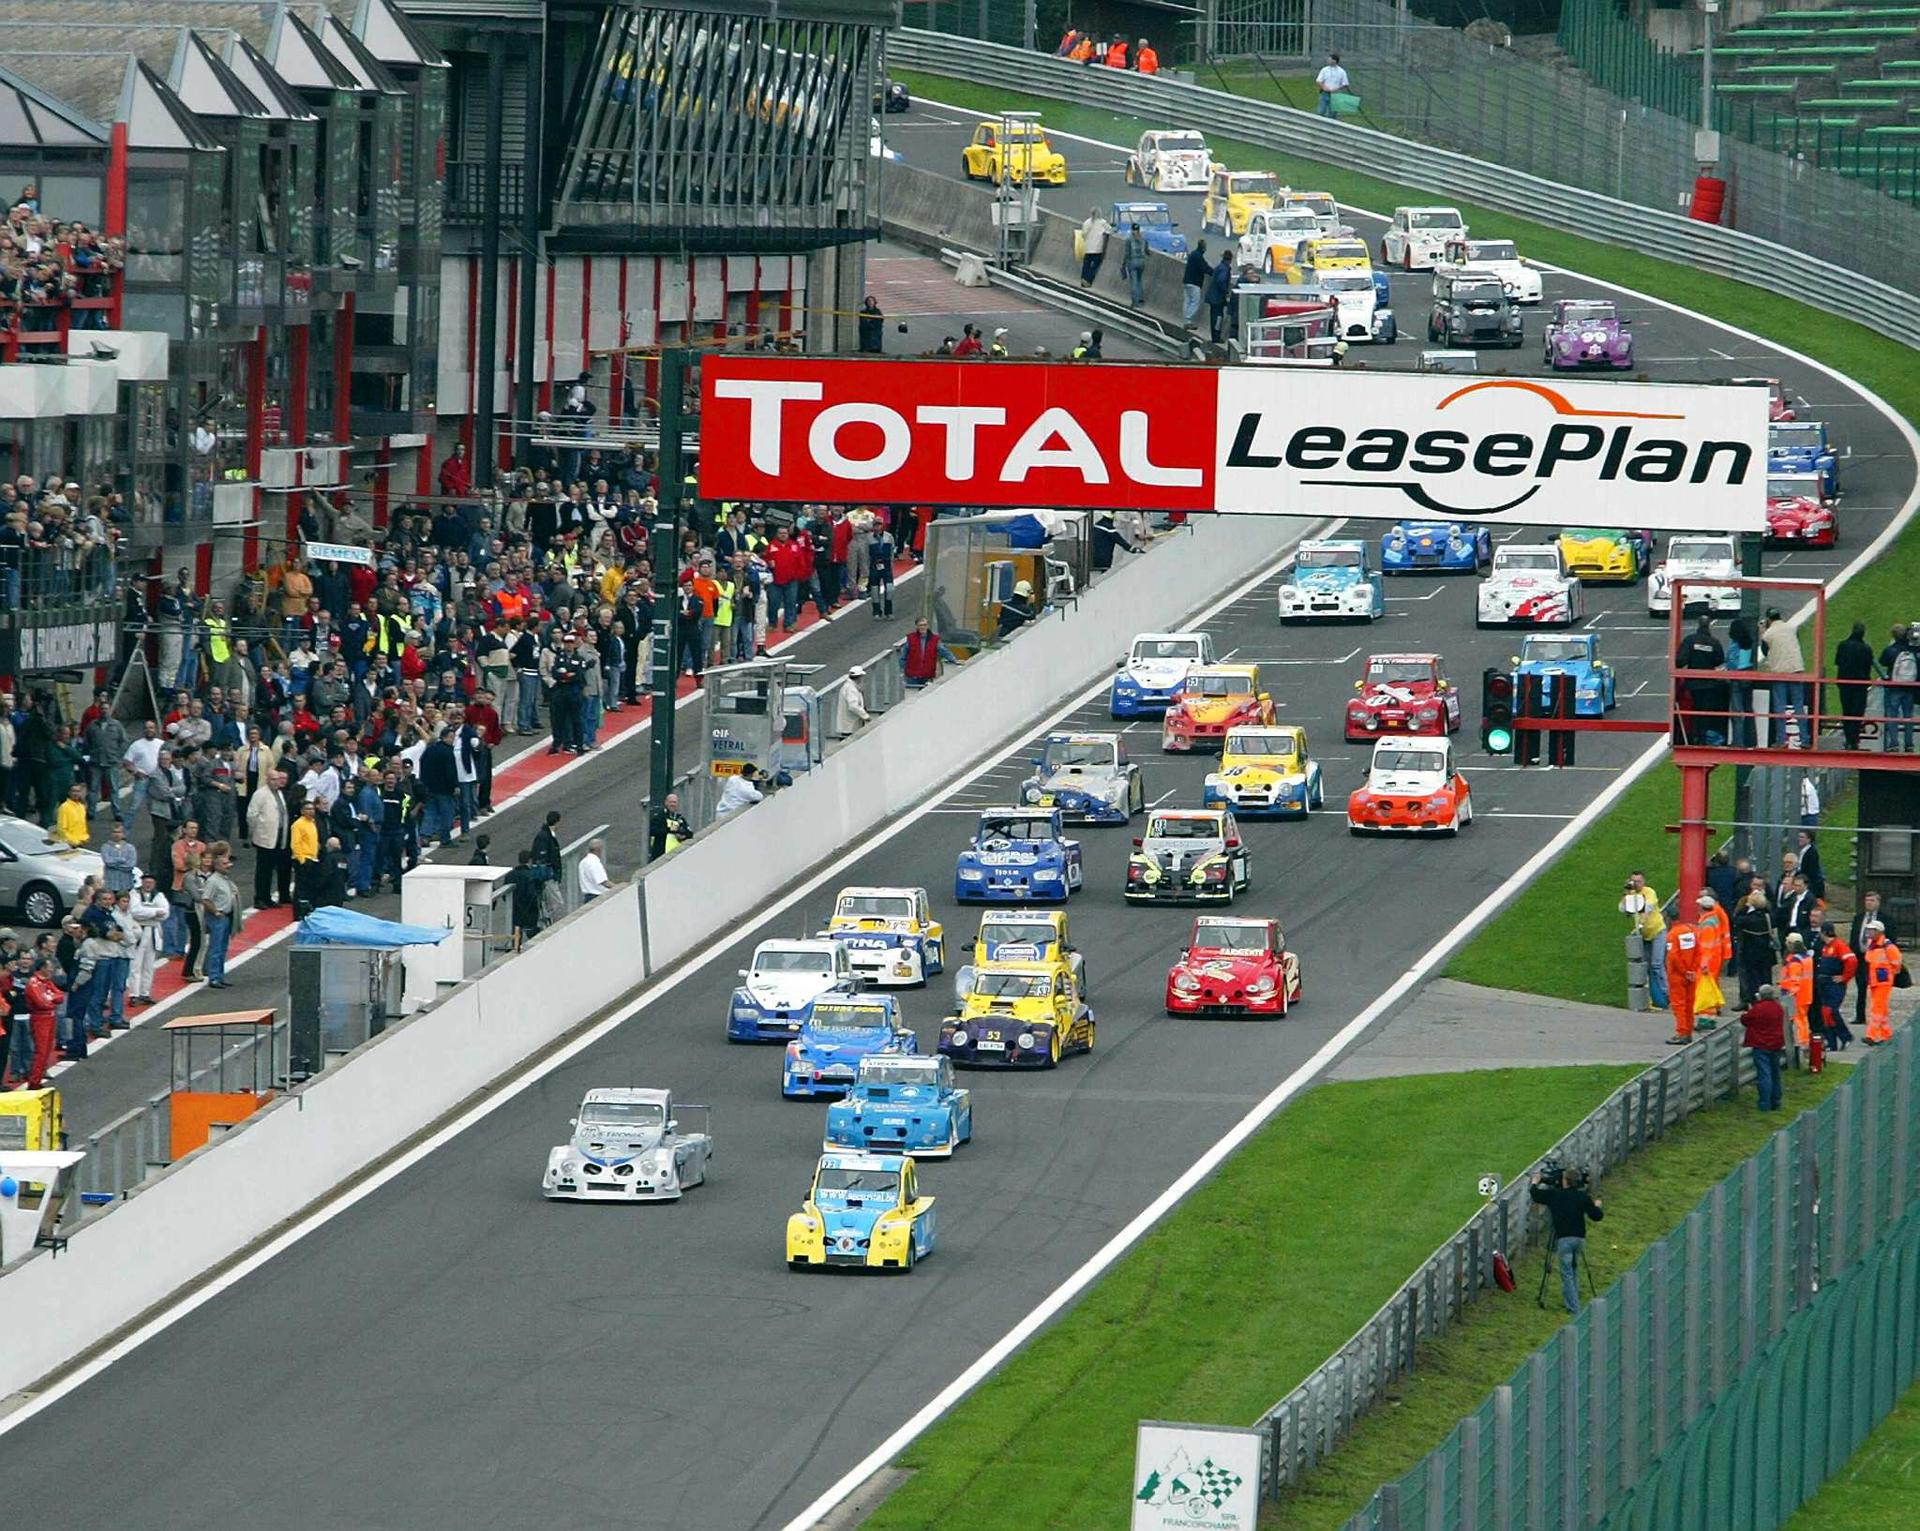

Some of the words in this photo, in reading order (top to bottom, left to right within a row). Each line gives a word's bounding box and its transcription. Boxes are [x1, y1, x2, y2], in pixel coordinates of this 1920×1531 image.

[714, 379, 1203, 488] TOTAL
[1226, 413, 1752, 485] LeasePlan
[311, 547, 367, 561] SIEMENS
[987, 1030, 1001, 1041] 53
